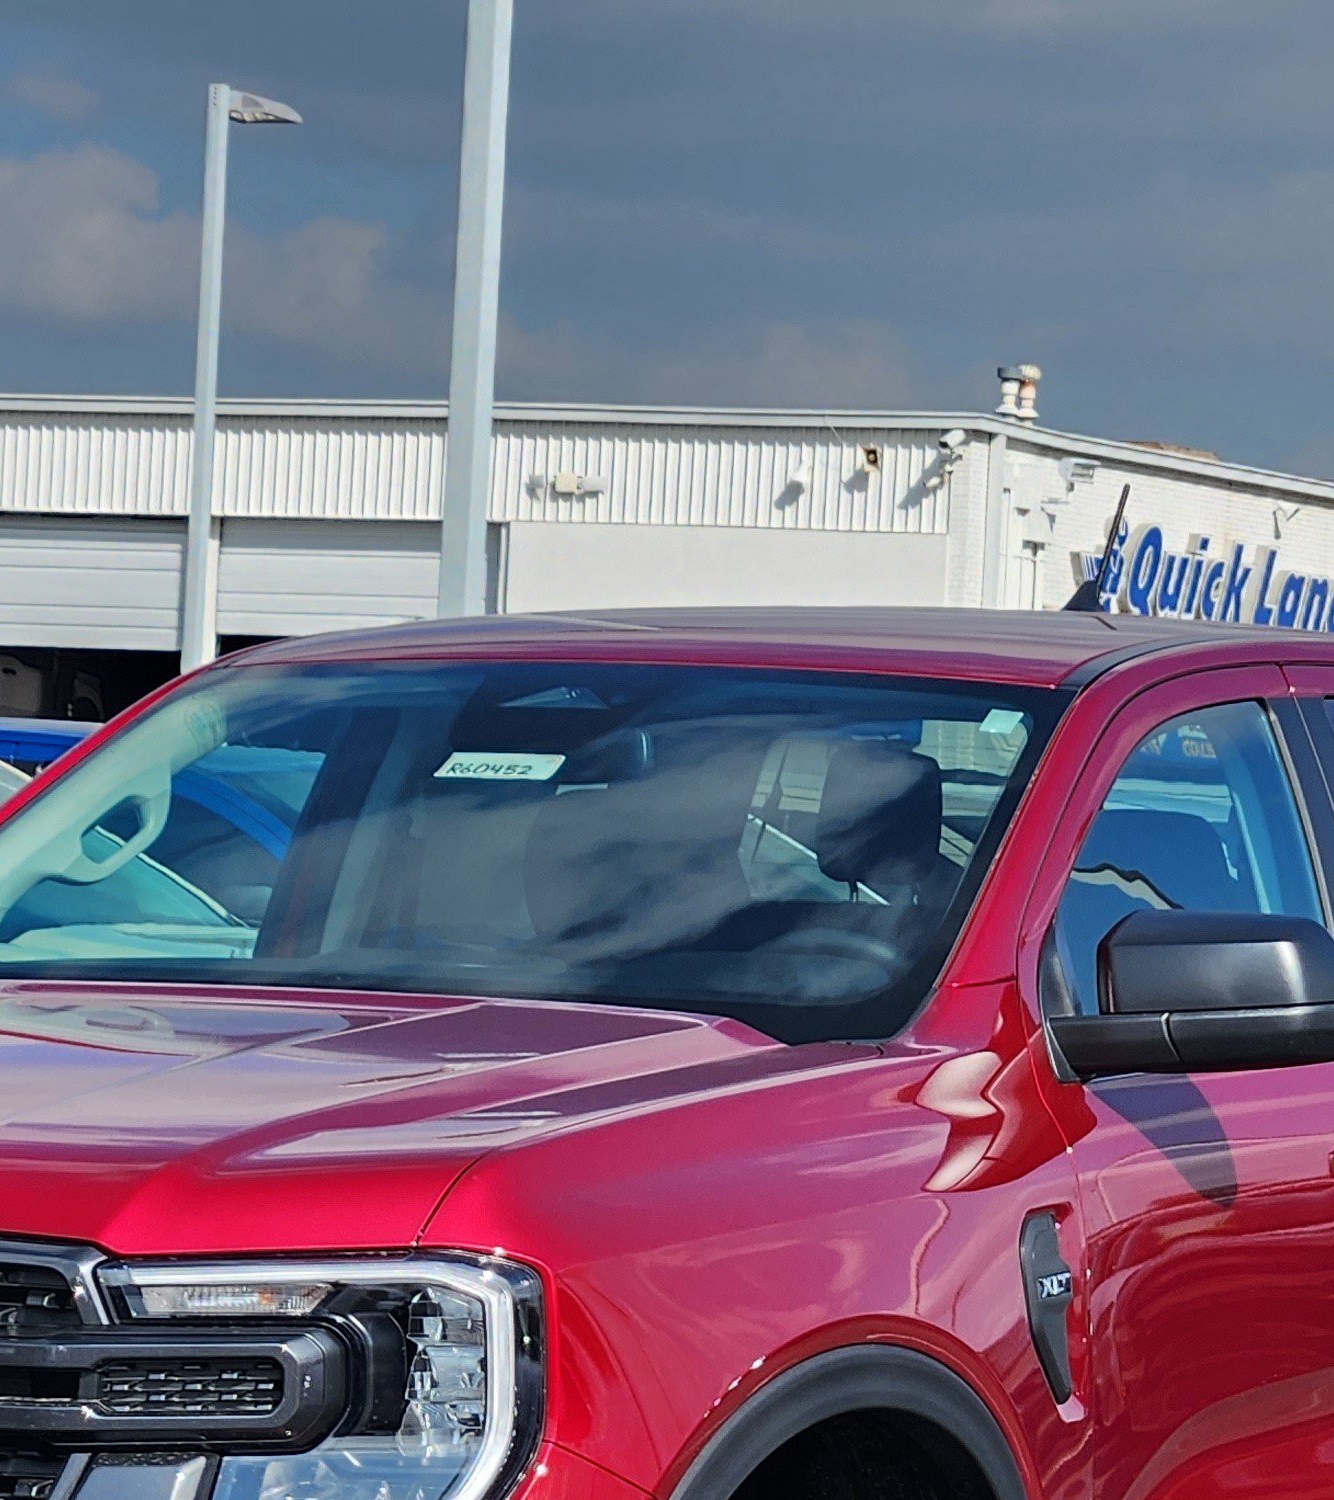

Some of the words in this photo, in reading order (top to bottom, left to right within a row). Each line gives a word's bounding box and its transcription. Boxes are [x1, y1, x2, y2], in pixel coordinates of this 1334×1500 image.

[1127, 523, 1252, 623] Quick
[445, 762, 533, 775] R60452
[1037, 1271, 1071, 1299] XLT
